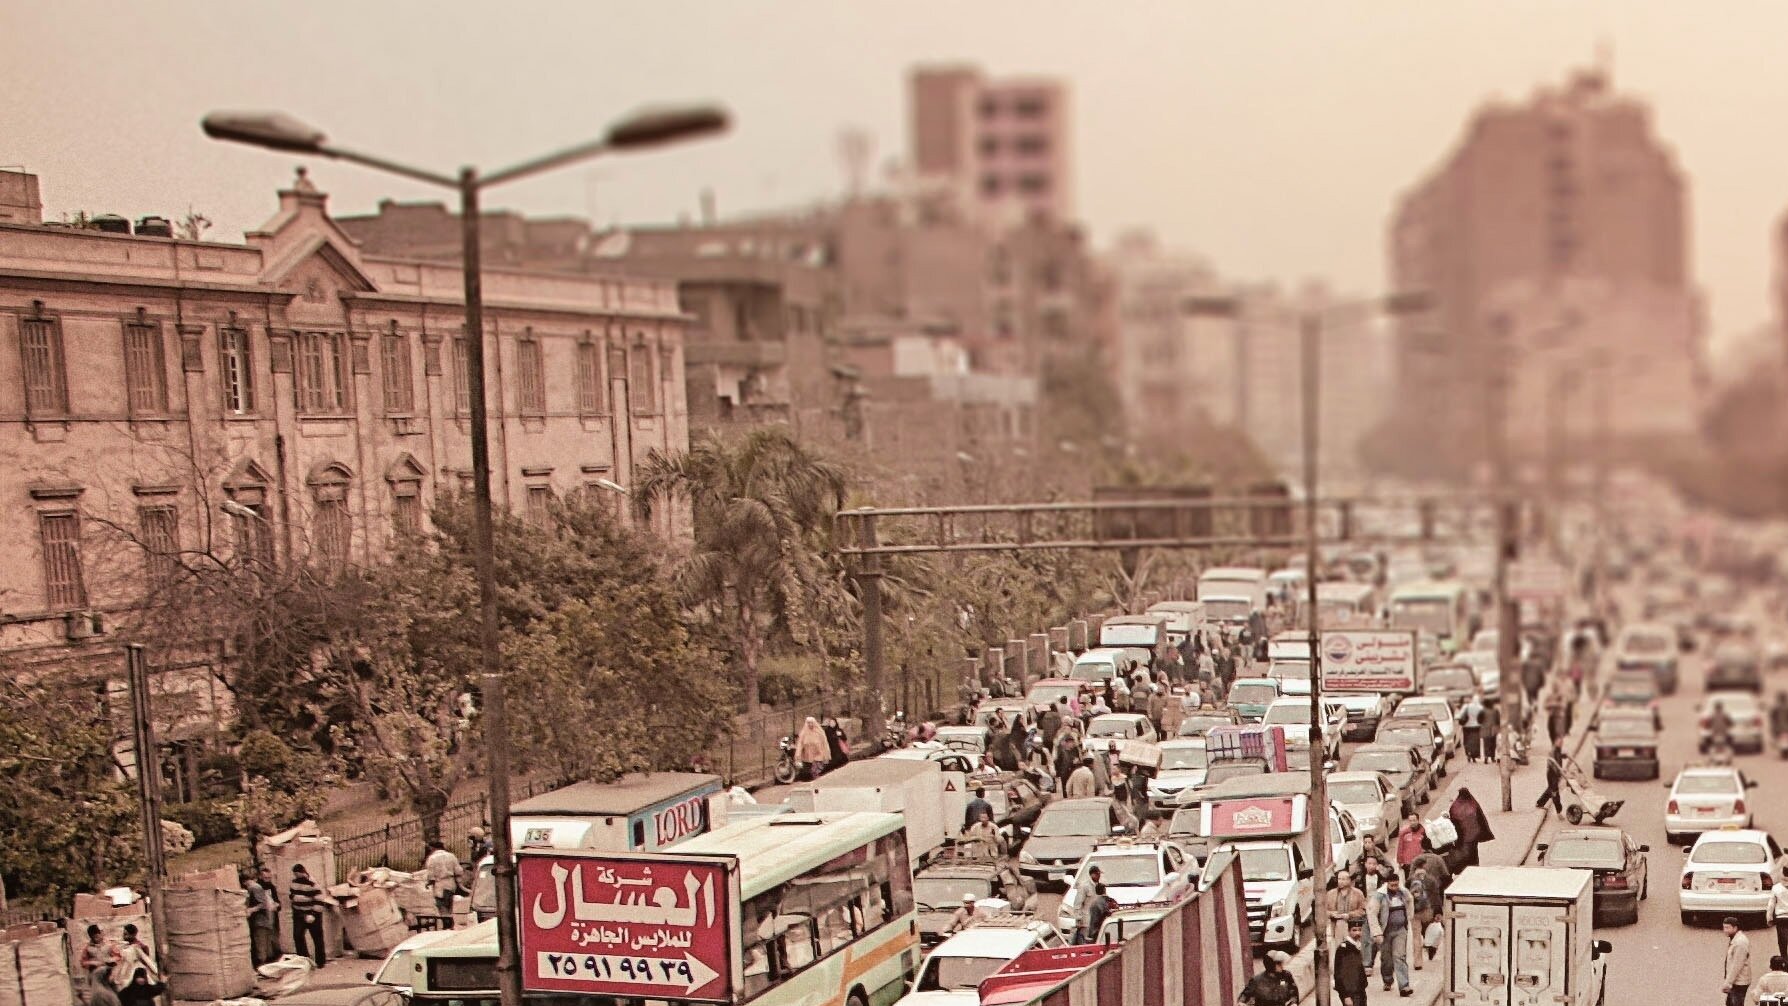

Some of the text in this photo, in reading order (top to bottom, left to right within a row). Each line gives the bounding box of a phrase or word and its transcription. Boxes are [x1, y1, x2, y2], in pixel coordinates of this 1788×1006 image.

[655, 797, 703, 846] LORD
[533, 862, 715, 929] العسال
[597, 867, 652, 888] شركة
[570, 922, 692, 951] للملابس الجاهزة
